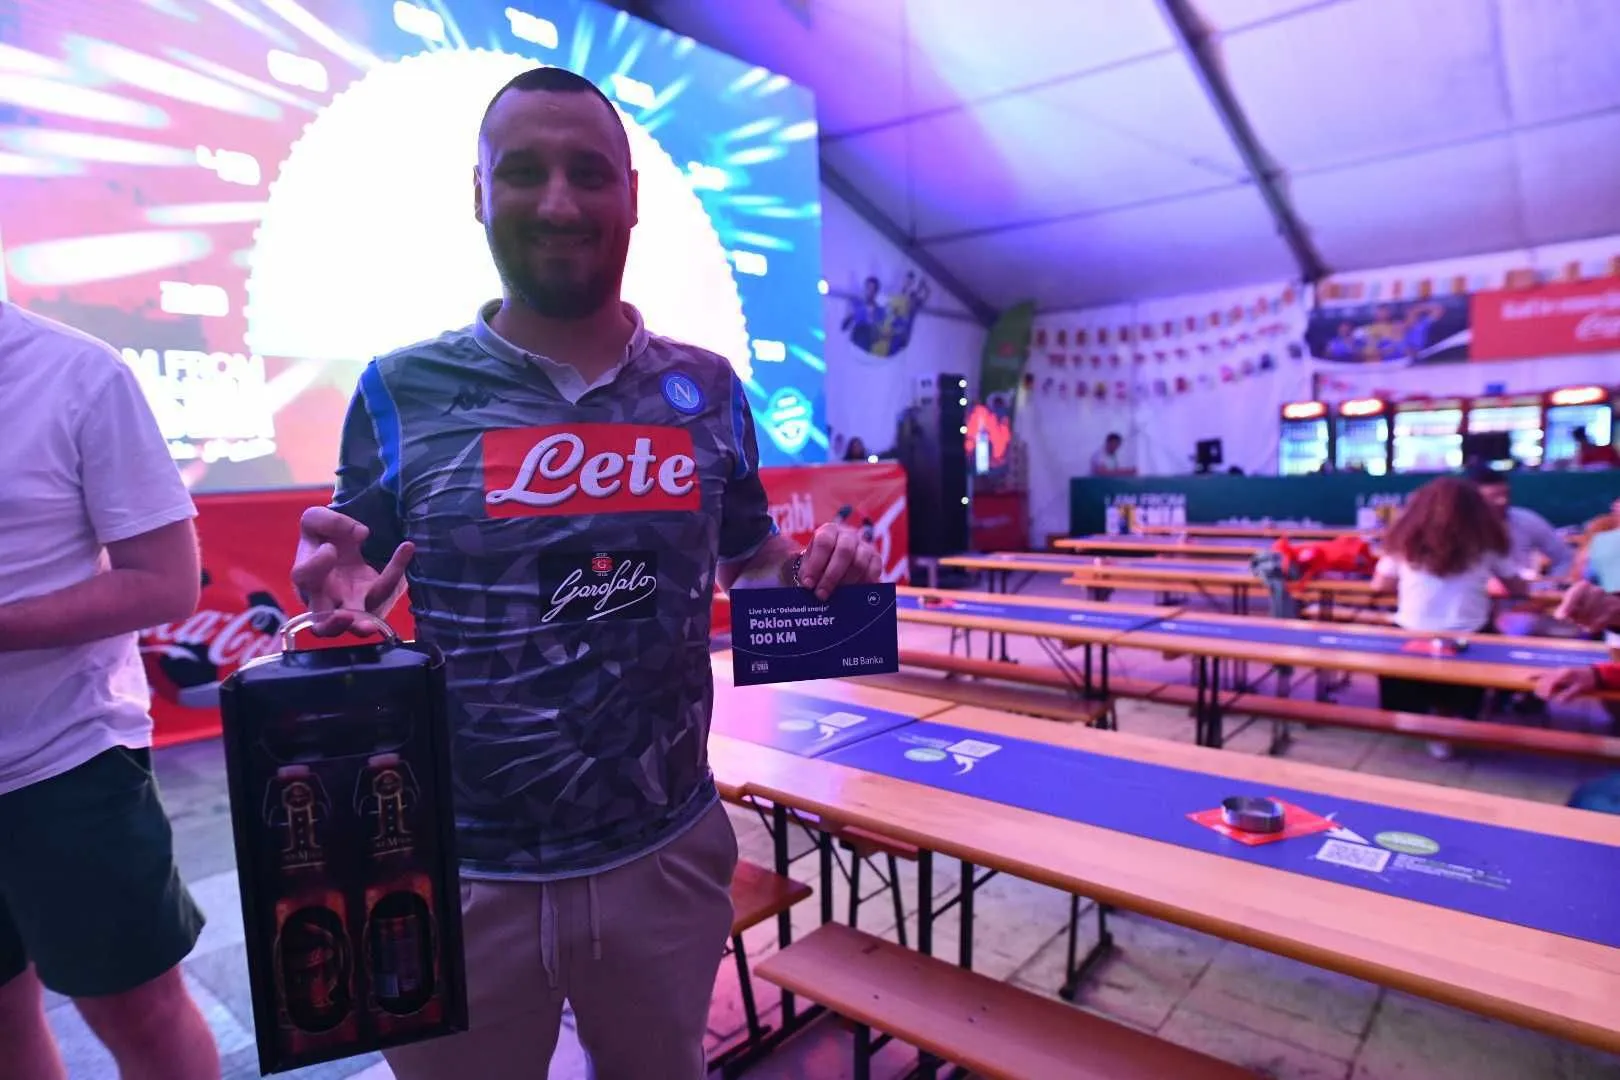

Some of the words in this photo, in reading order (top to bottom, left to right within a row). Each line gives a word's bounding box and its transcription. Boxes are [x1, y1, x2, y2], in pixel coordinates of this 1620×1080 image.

[673, 381, 693, 402] N
[485, 432, 697, 506] Lete
[541, 559, 657, 623] Garofalo
[750, 617, 792, 630] Poklon
[794, 615, 835, 627] vaučer
[750, 632, 773, 645] 100
[776, 631, 797, 644] KM
[842, 657, 859, 667] NLB
[860, 655, 884, 666] Banka
